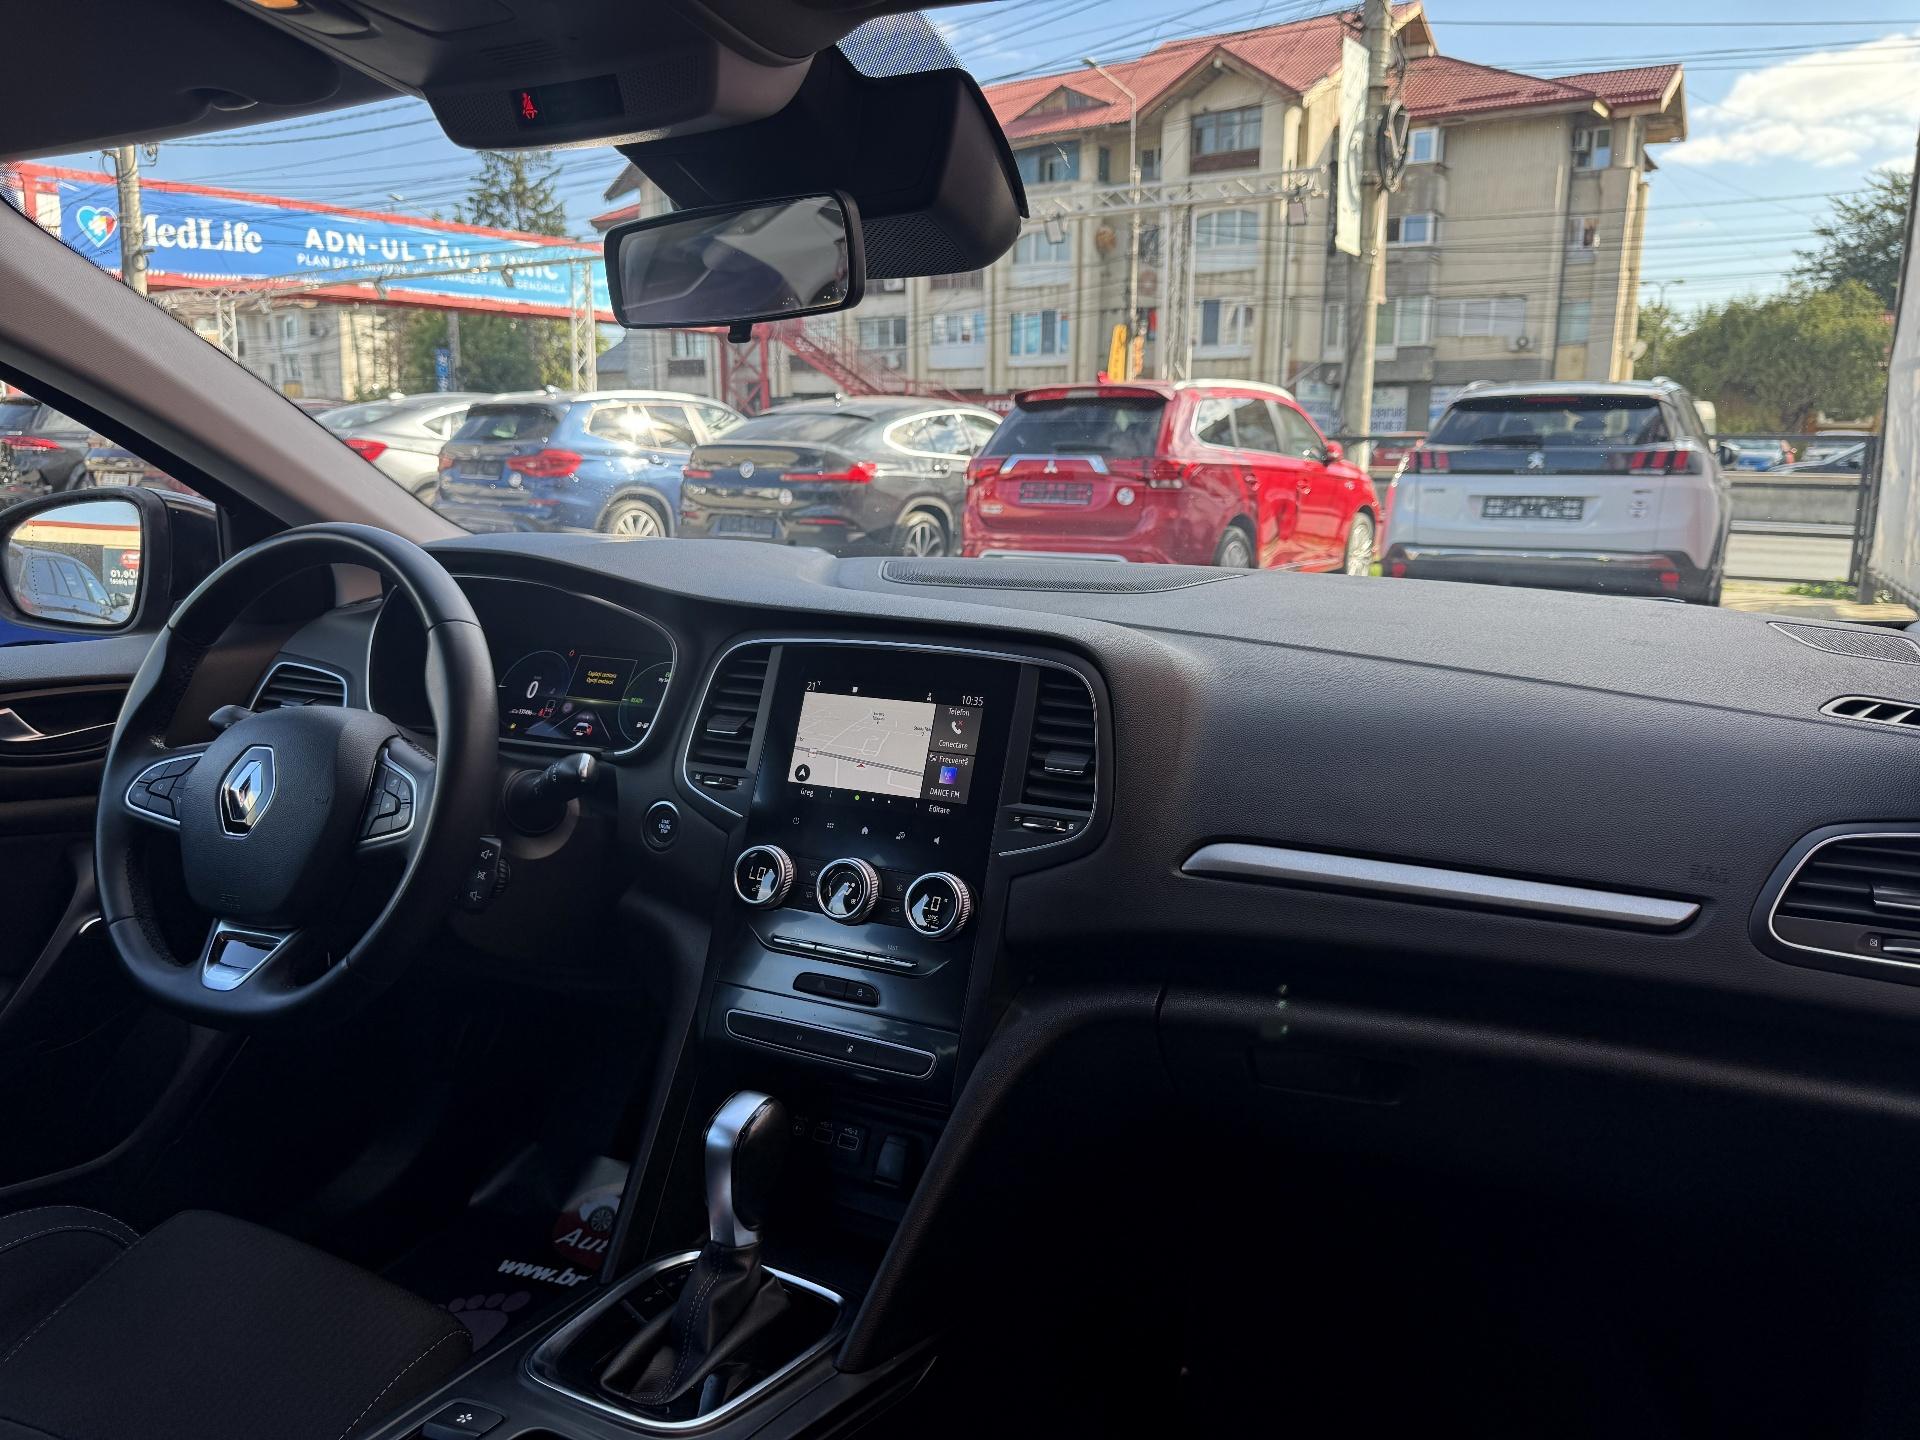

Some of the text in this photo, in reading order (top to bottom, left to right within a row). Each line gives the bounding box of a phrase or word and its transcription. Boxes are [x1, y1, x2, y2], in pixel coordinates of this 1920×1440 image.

[304, 226, 416, 262] ADN-UL
[296, 252, 330, 268] PLAN
[526, 680, 539, 699] 0
[962, 695, 984, 706] 10:35
[949, 707, 970, 716] Telefon
[938, 739, 969, 750] Conectare
[929, 786, 961, 798] DANCE FM
[928, 804, 951, 815] Editare
